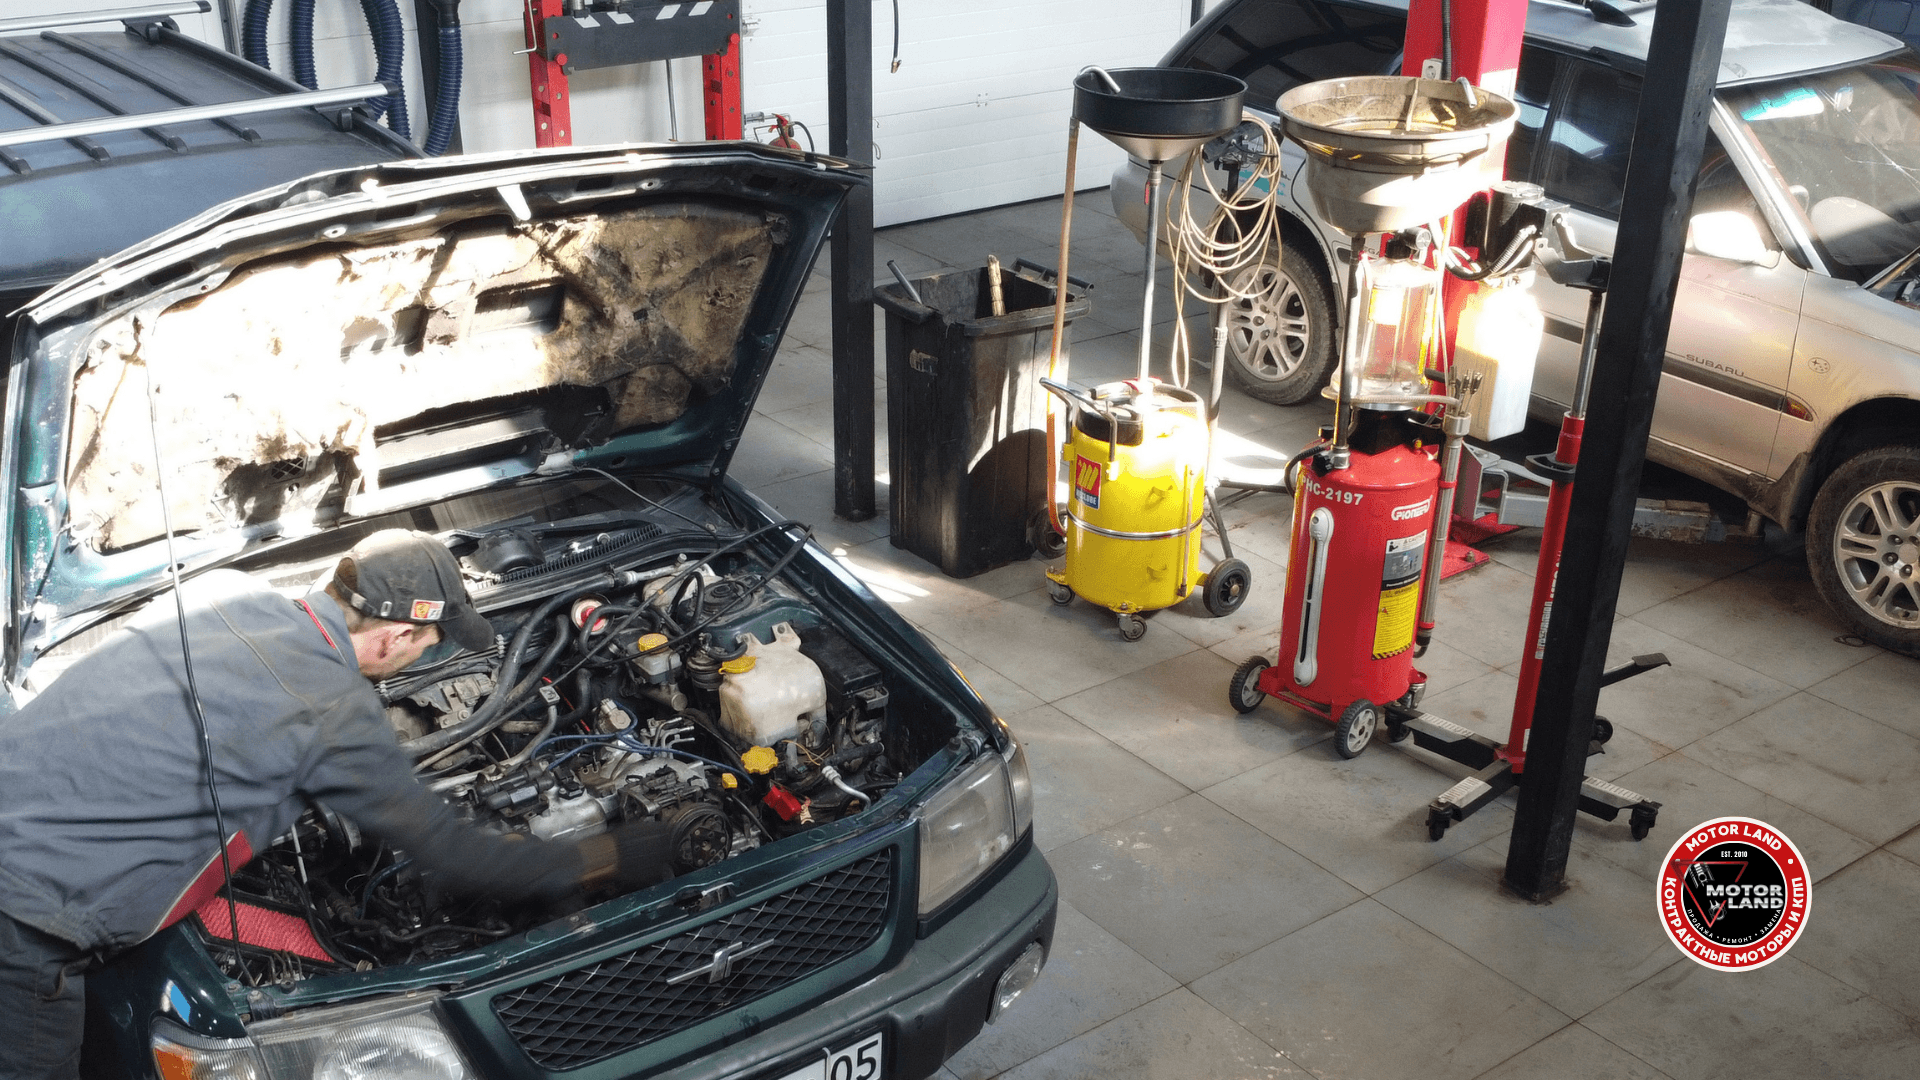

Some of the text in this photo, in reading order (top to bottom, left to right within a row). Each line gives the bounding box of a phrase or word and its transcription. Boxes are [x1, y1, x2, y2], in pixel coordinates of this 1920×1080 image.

[1686, 354, 1744, 377] SUBARU
[1392, 500, 1430, 521] PIONEER
[830, 1039, 879, 1080] 05
